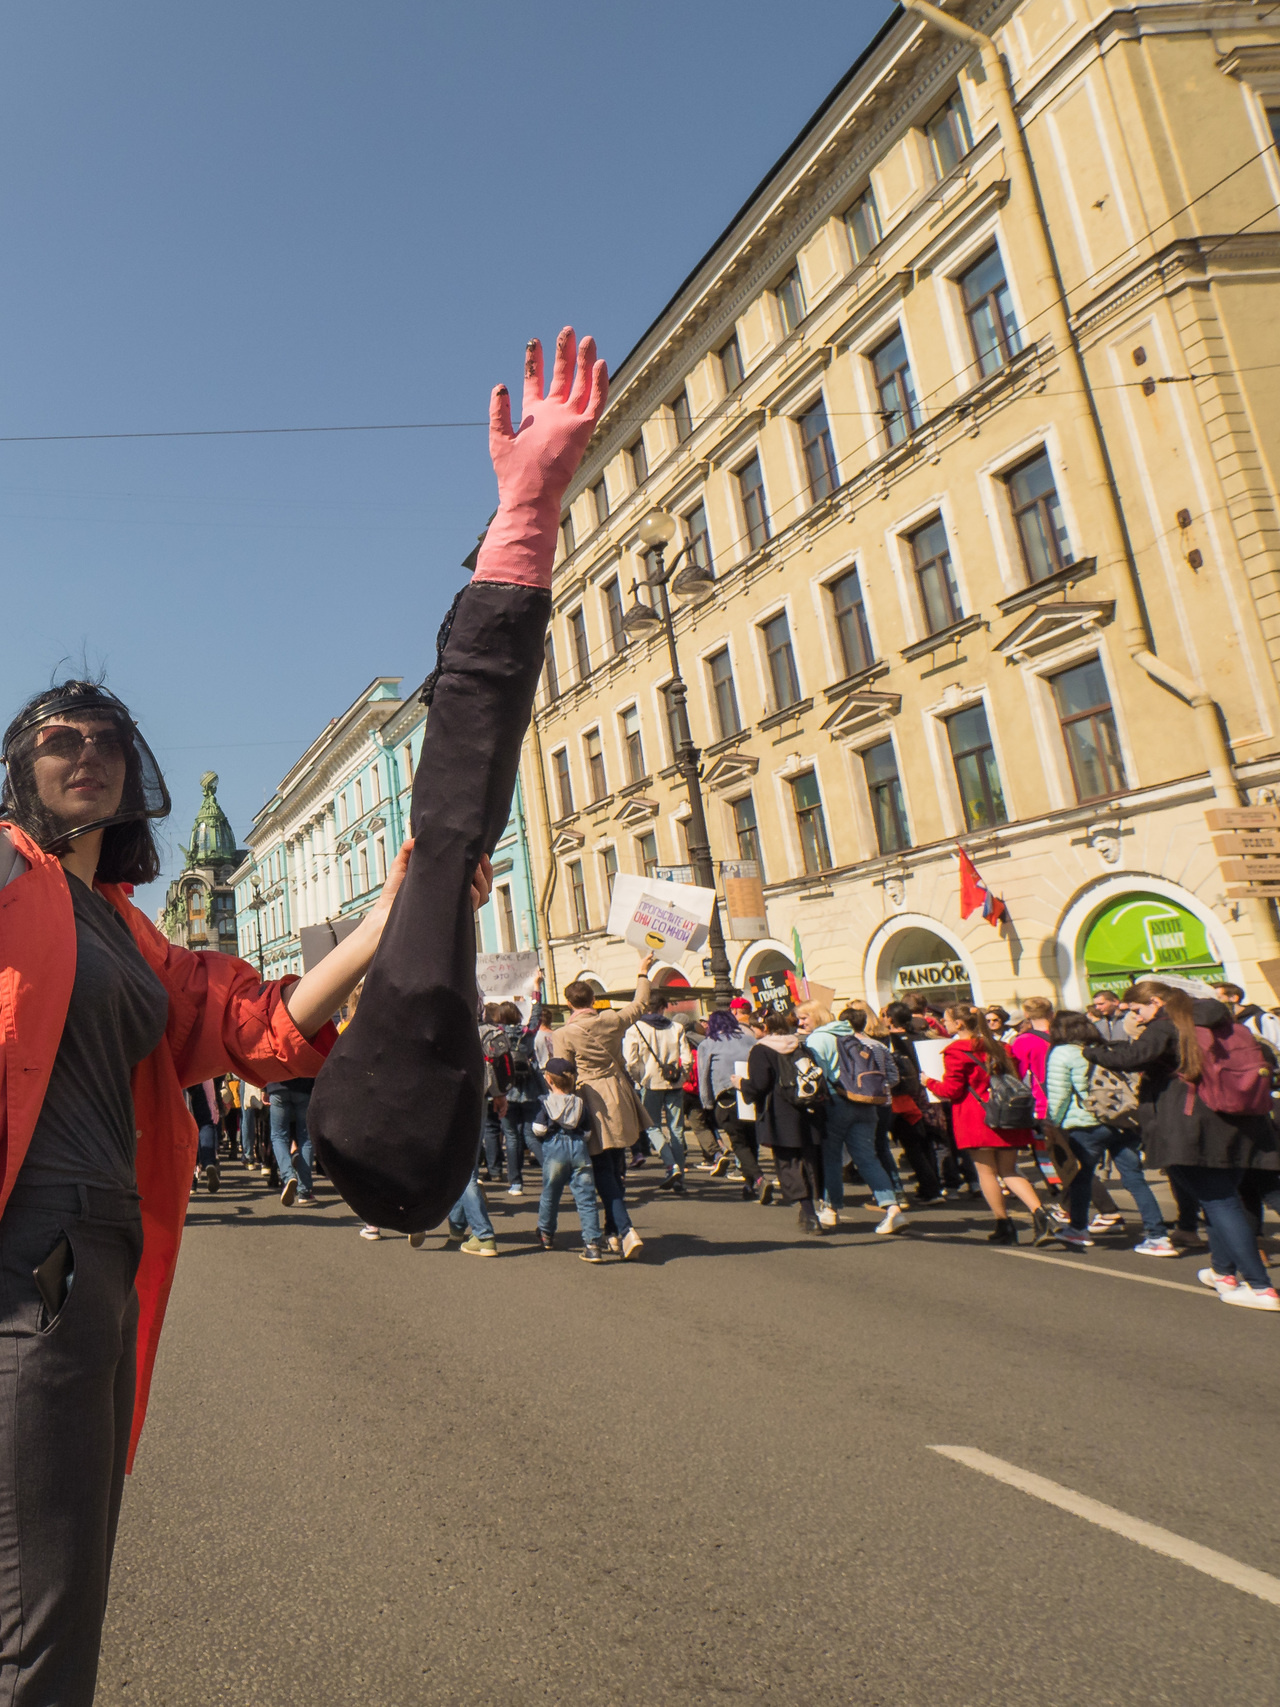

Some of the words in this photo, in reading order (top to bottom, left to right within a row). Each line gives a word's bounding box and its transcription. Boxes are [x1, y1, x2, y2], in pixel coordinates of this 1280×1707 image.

[634, 911, 652, 927] ОНИ
[651, 919, 667, 933] СО
[639, 901, 683, 927] ПРОПУСТИТЕ
[683, 919, 696, 931] ИХ
[762, 976, 775, 989] НЕ
[1091, 980, 1132, 991] INCANTO
